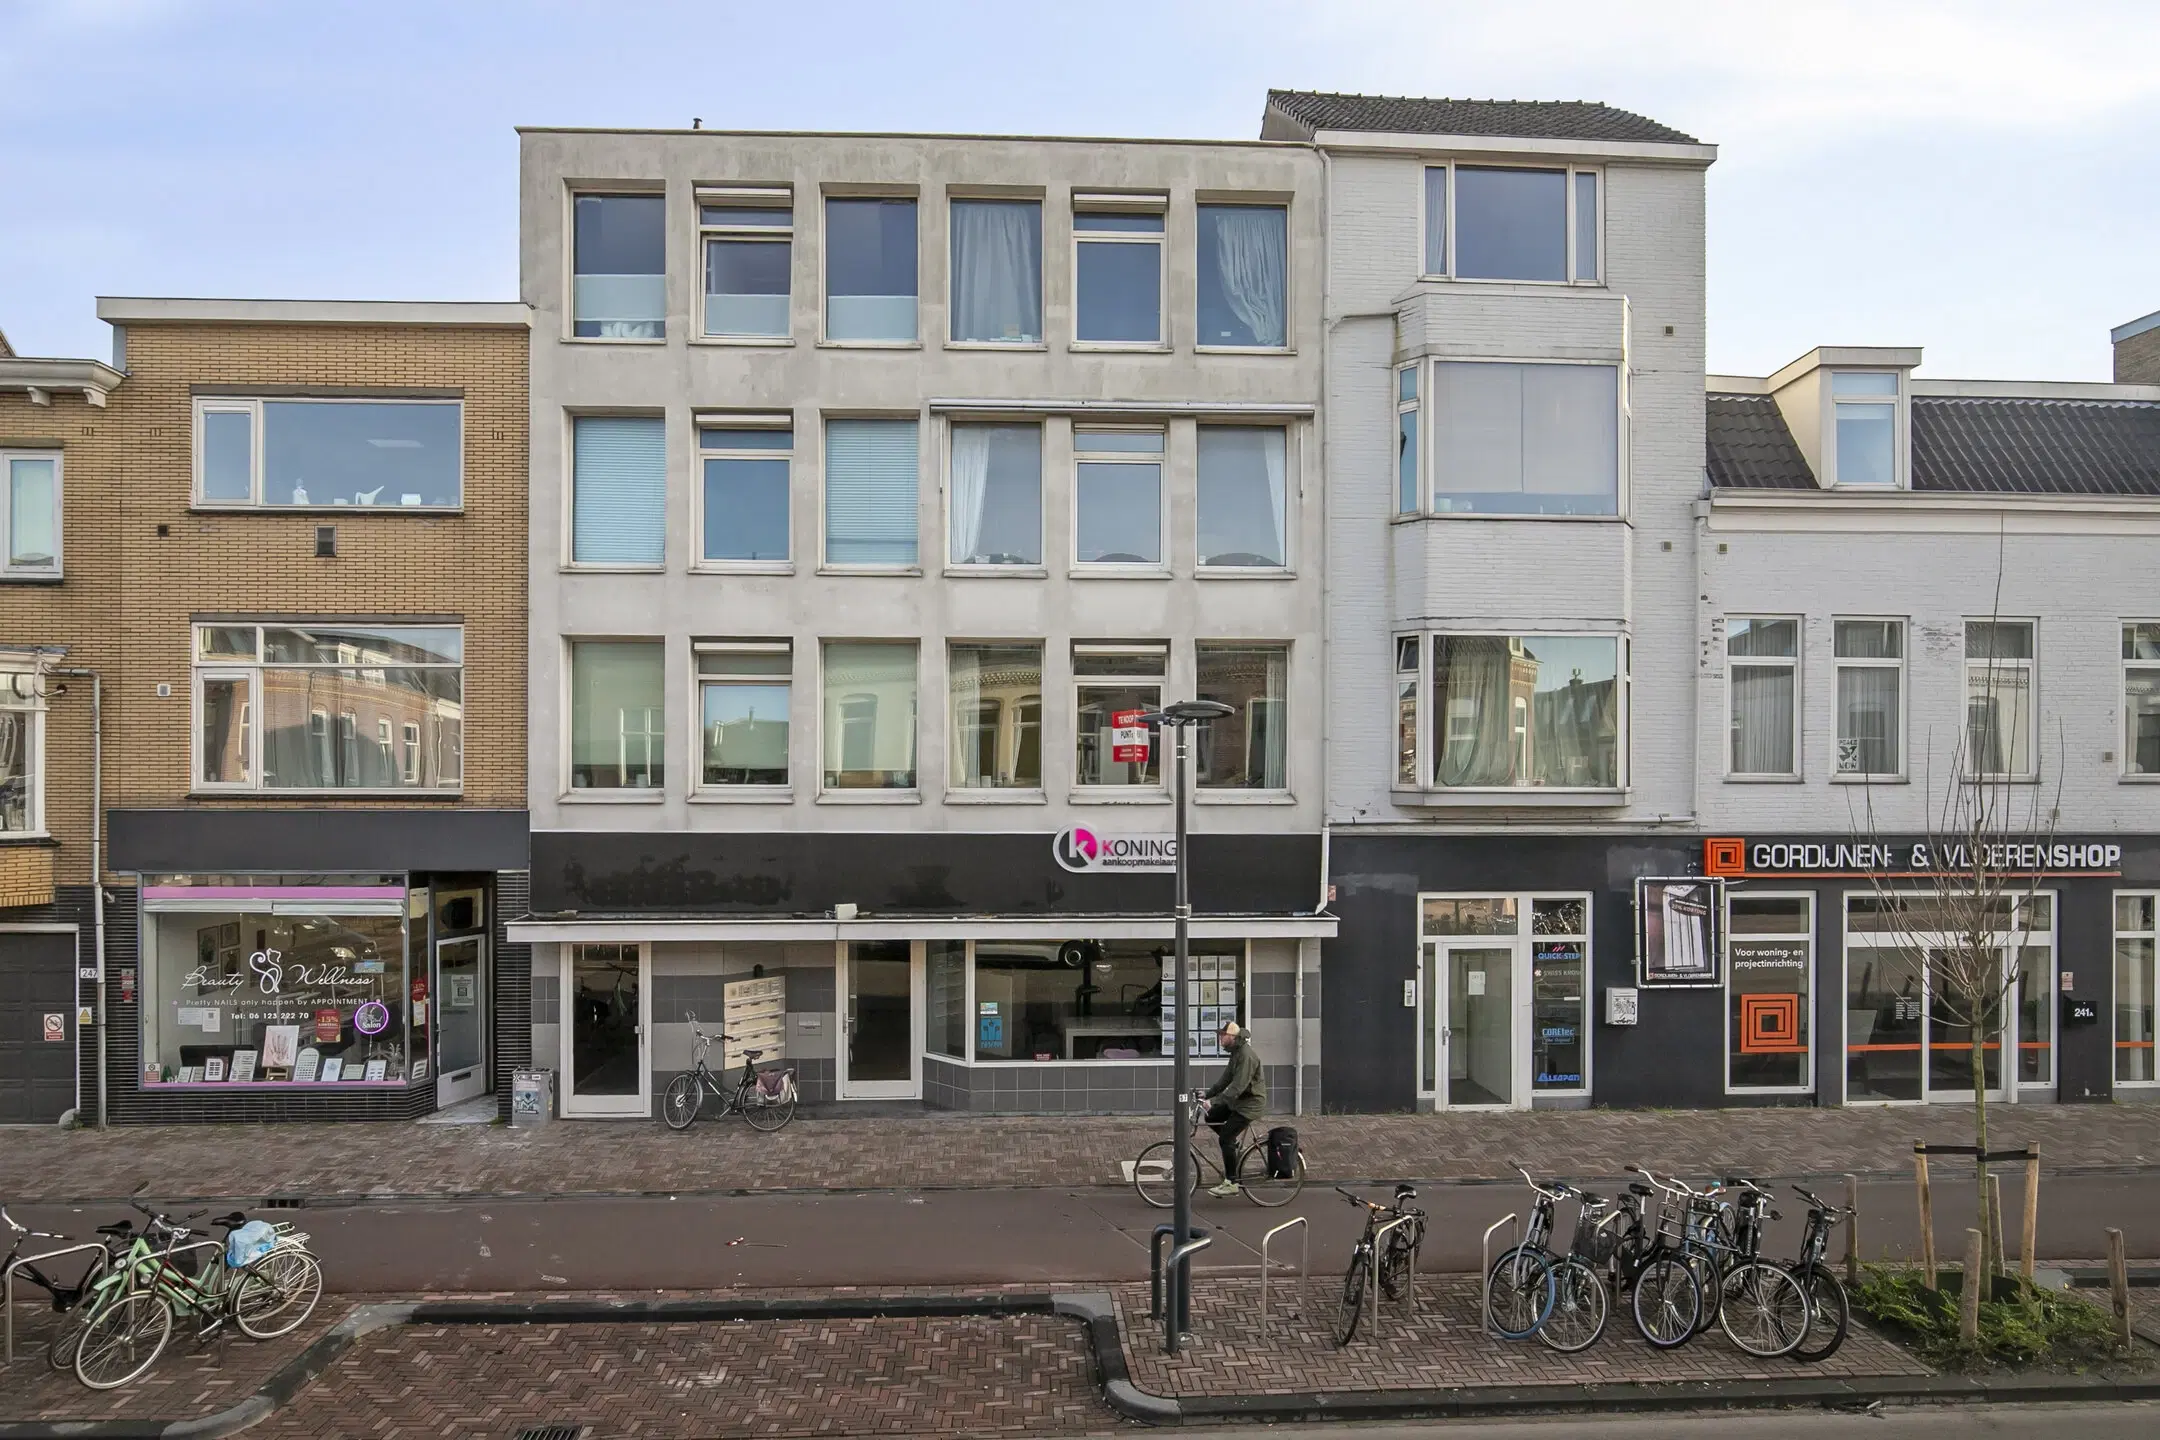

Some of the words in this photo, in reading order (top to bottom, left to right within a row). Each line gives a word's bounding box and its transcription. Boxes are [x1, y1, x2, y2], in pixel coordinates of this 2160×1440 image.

[1102, 839, 1177, 857] KONING
[1911, 843, 1930, 867] &
[1734, 948, 1755, 957] Voor
[1757, 948, 1791, 958] woning-
[1734, 959, 1804, 970] projectinrichting
[82, 969, 97, 978] 247
[181, 965, 244, 996] Beauty
[288, 963, 375, 985] Wellness
[186, 999, 211, 1007] Pretty
[261, 999, 294, 1007] happen
[297, 998, 307, 1006] by
[231, 1012, 246, 1020] Tel:
